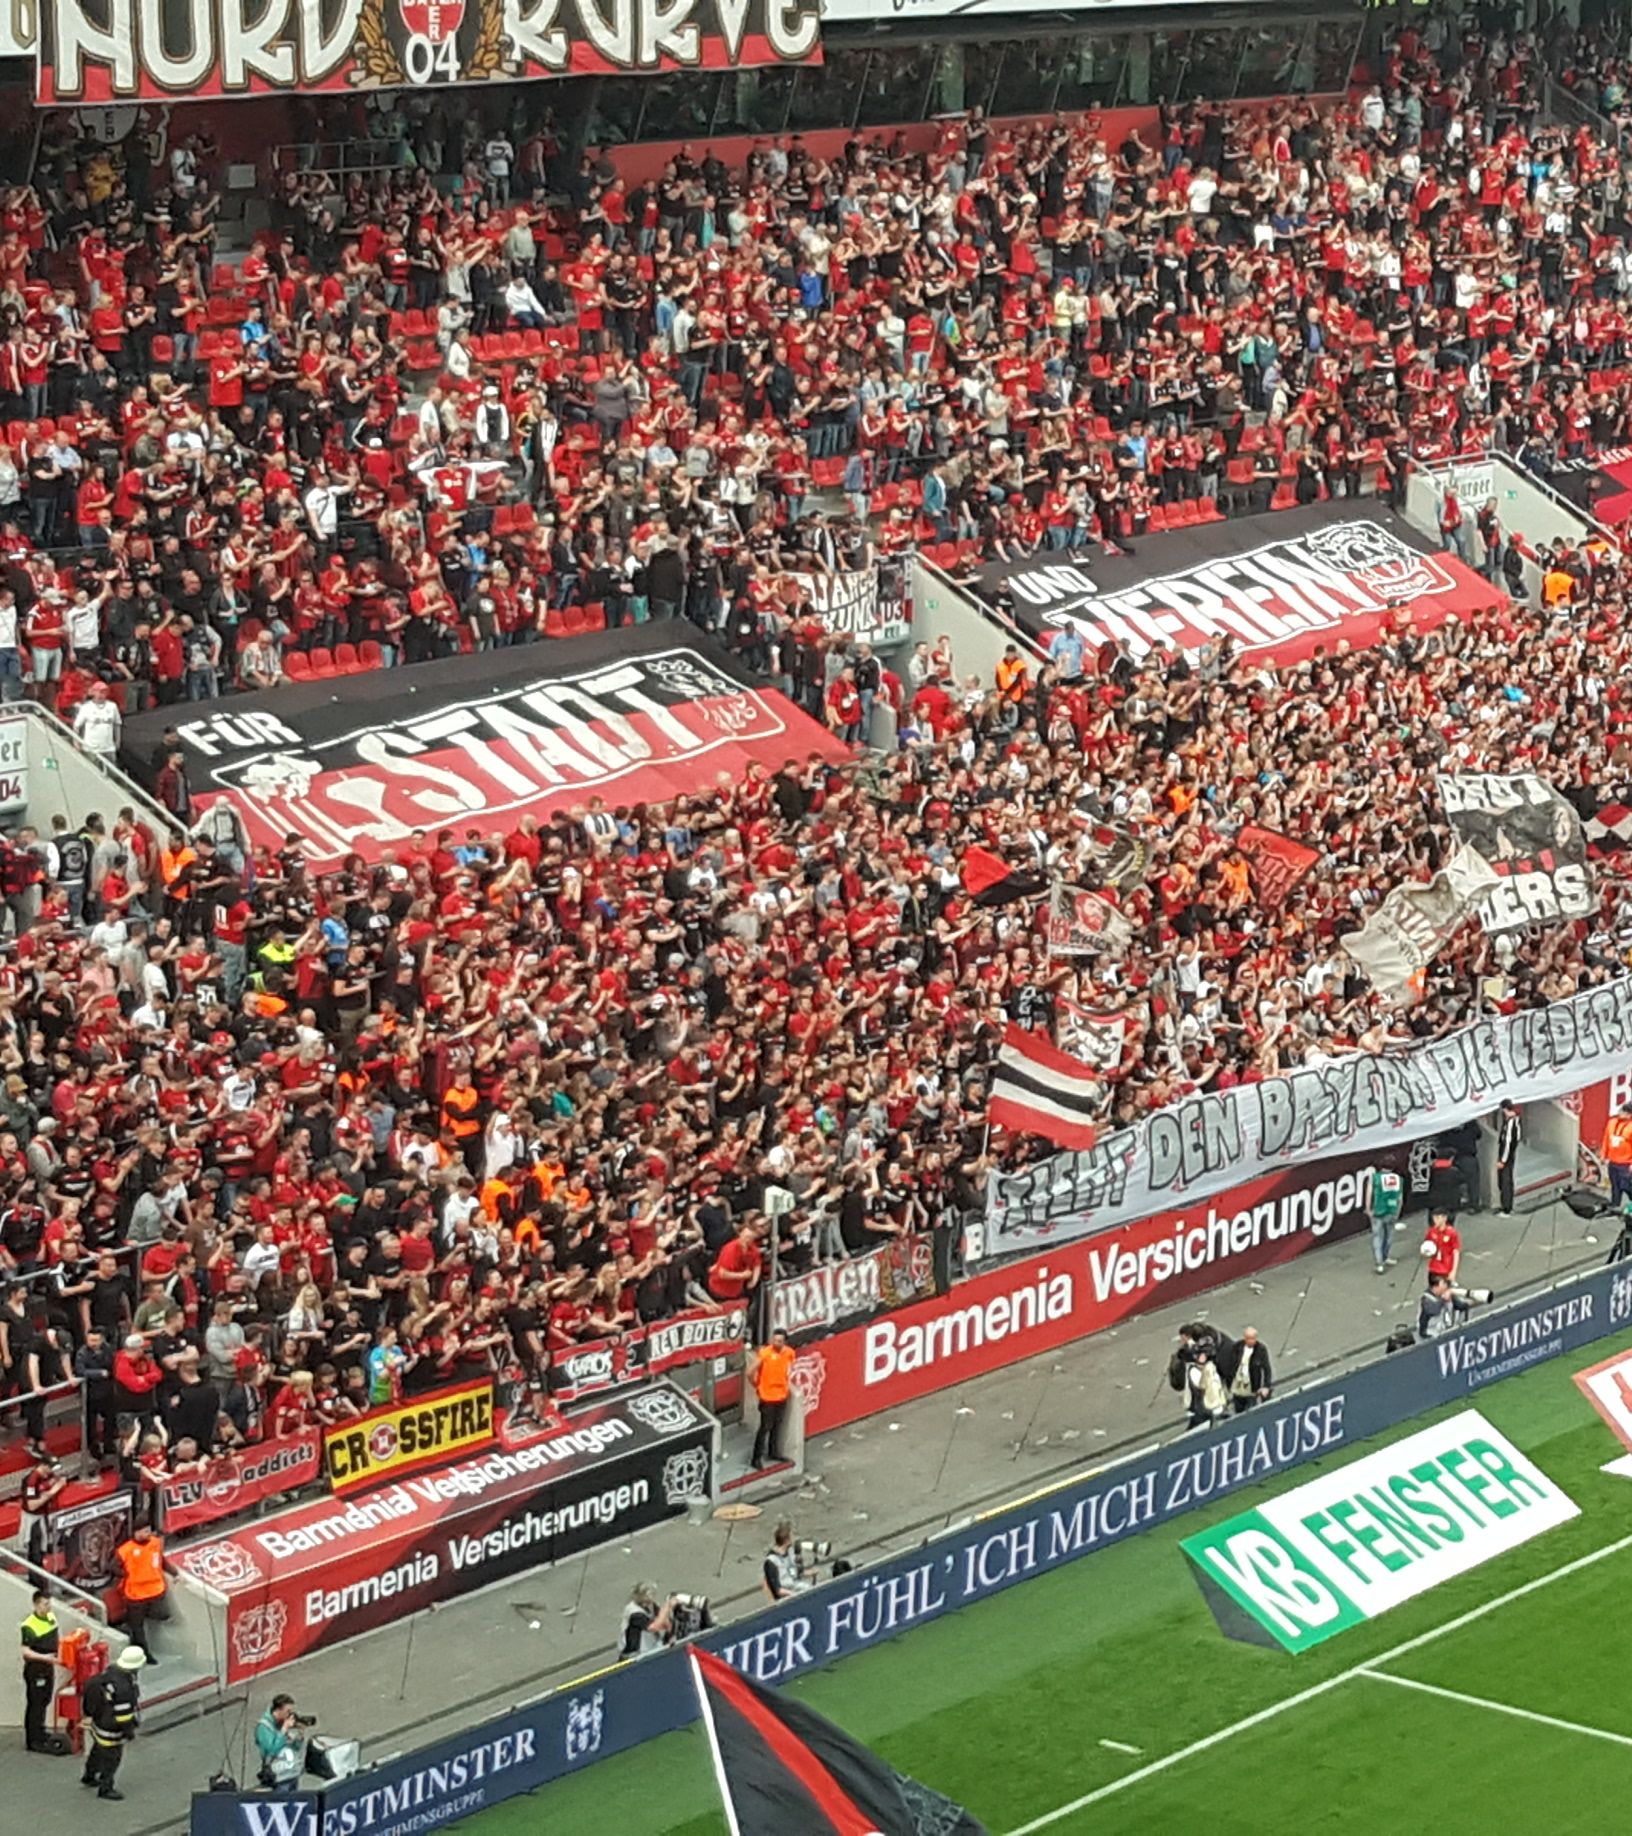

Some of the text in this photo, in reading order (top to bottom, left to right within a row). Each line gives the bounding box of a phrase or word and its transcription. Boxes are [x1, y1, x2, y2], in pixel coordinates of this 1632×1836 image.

[405, 31, 461, 84] 04
[1008, 564, 1098, 605] UND
[178, 711, 303, 756] FÜR
[355, 665, 704, 812] STADT
[1148, 1096, 1242, 1191] DEN
[1431, 1022, 1508, 1105] DIE
[862, 1165, 1376, 1386] Barmenia Versicherungen
[1437, 1294, 1594, 1379] WESTMINSTER
[304, 1476, 649, 1627] Barmenia Versicherungen
[963, 1518, 1039, 1597] ICH
[1047, 1470, 1159, 1560] MICH
[1165, 1394, 1346, 1511] ZUHAUSE
[1204, 1438, 1549, 1638] KB FENSTER
